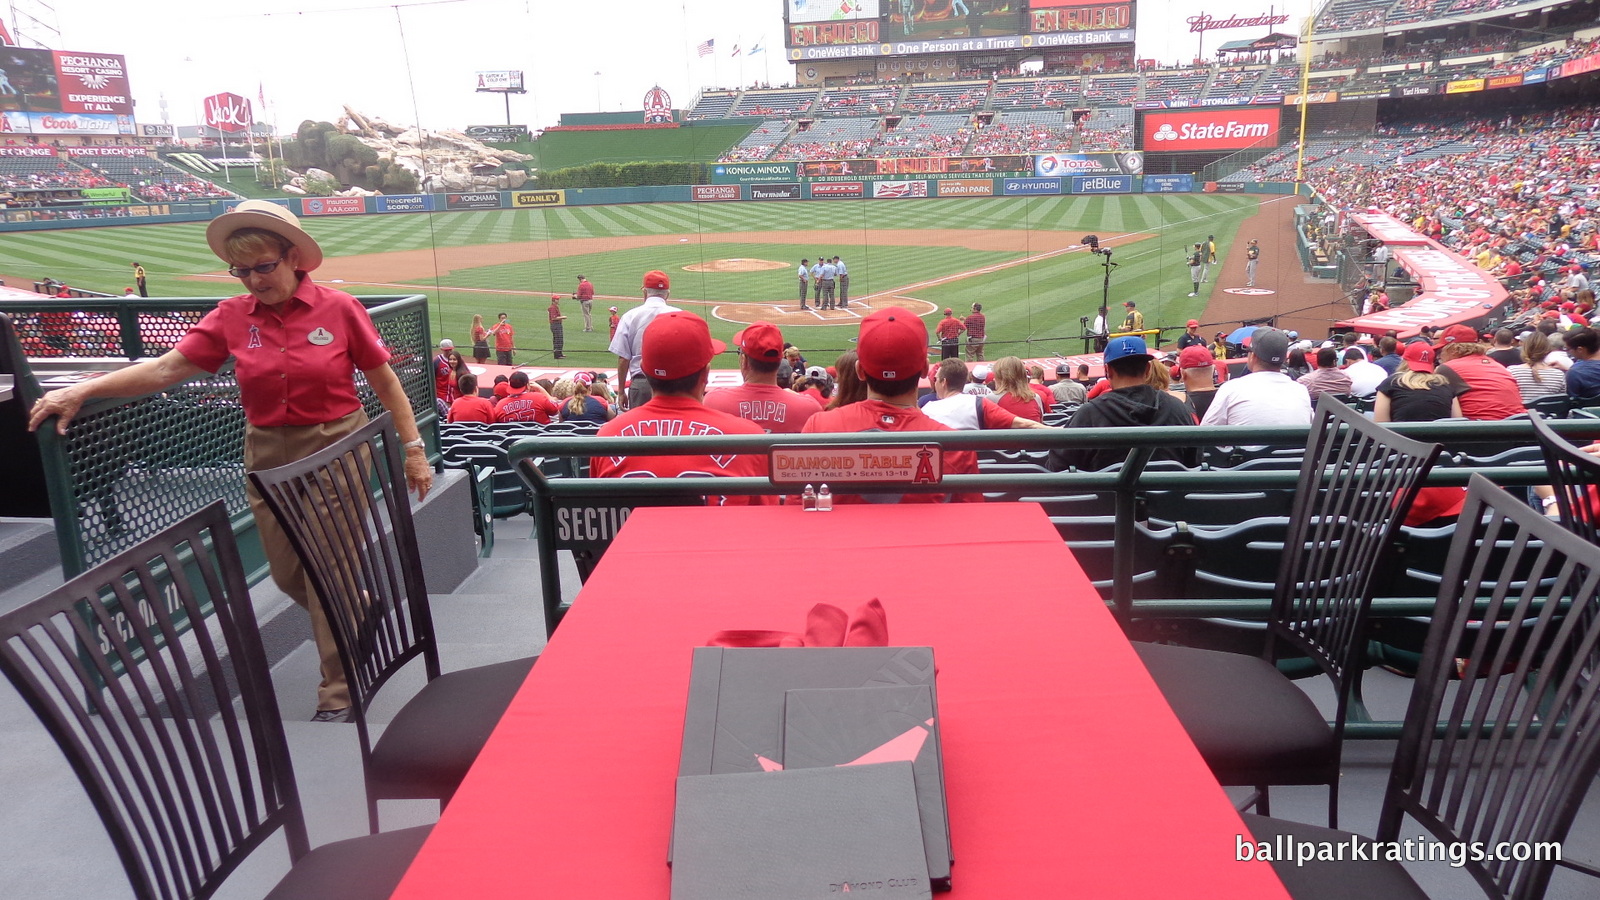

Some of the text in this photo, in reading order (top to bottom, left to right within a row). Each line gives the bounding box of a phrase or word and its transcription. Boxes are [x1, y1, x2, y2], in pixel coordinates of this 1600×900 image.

[1030, 6, 1130, 32] EN FUEGO
[1186, 14, 1290, 33] Budweiser
[791, 21, 879, 46] EN FUEGO
[1038, 34, 1084, 46] OneWest
[1086, 32, 1112, 41] Bank
[808, 44, 874, 58] OneWest Bank
[897, 38, 1014, 54] One Person at a Time
[59, 55, 122, 69] PECHANGA
[95, 68, 123, 76] CASINO
[68, 94, 126, 104] EXPERIENCE
[41, 116, 113, 130] Coors LIGHT
[726, 166, 791, 175] KONICA MINOLTA
[1061, 160, 1102, 168] TOTAL
[697, 187, 736, 195] PECHANGA
[940, 186, 968, 194] SAFARI
[1021, 182, 1059, 190] HYUNDAI
[1081, 177, 1122, 192] jetBlue
[520, 194, 557, 203] STANLEY
[752, 190, 791, 198] Thermador
[1357, 298, 1482, 328] HOME
[502, 399, 534, 414] TROUT
[738, 401, 788, 424] PAPA
[800, 470, 812, 478] 117
